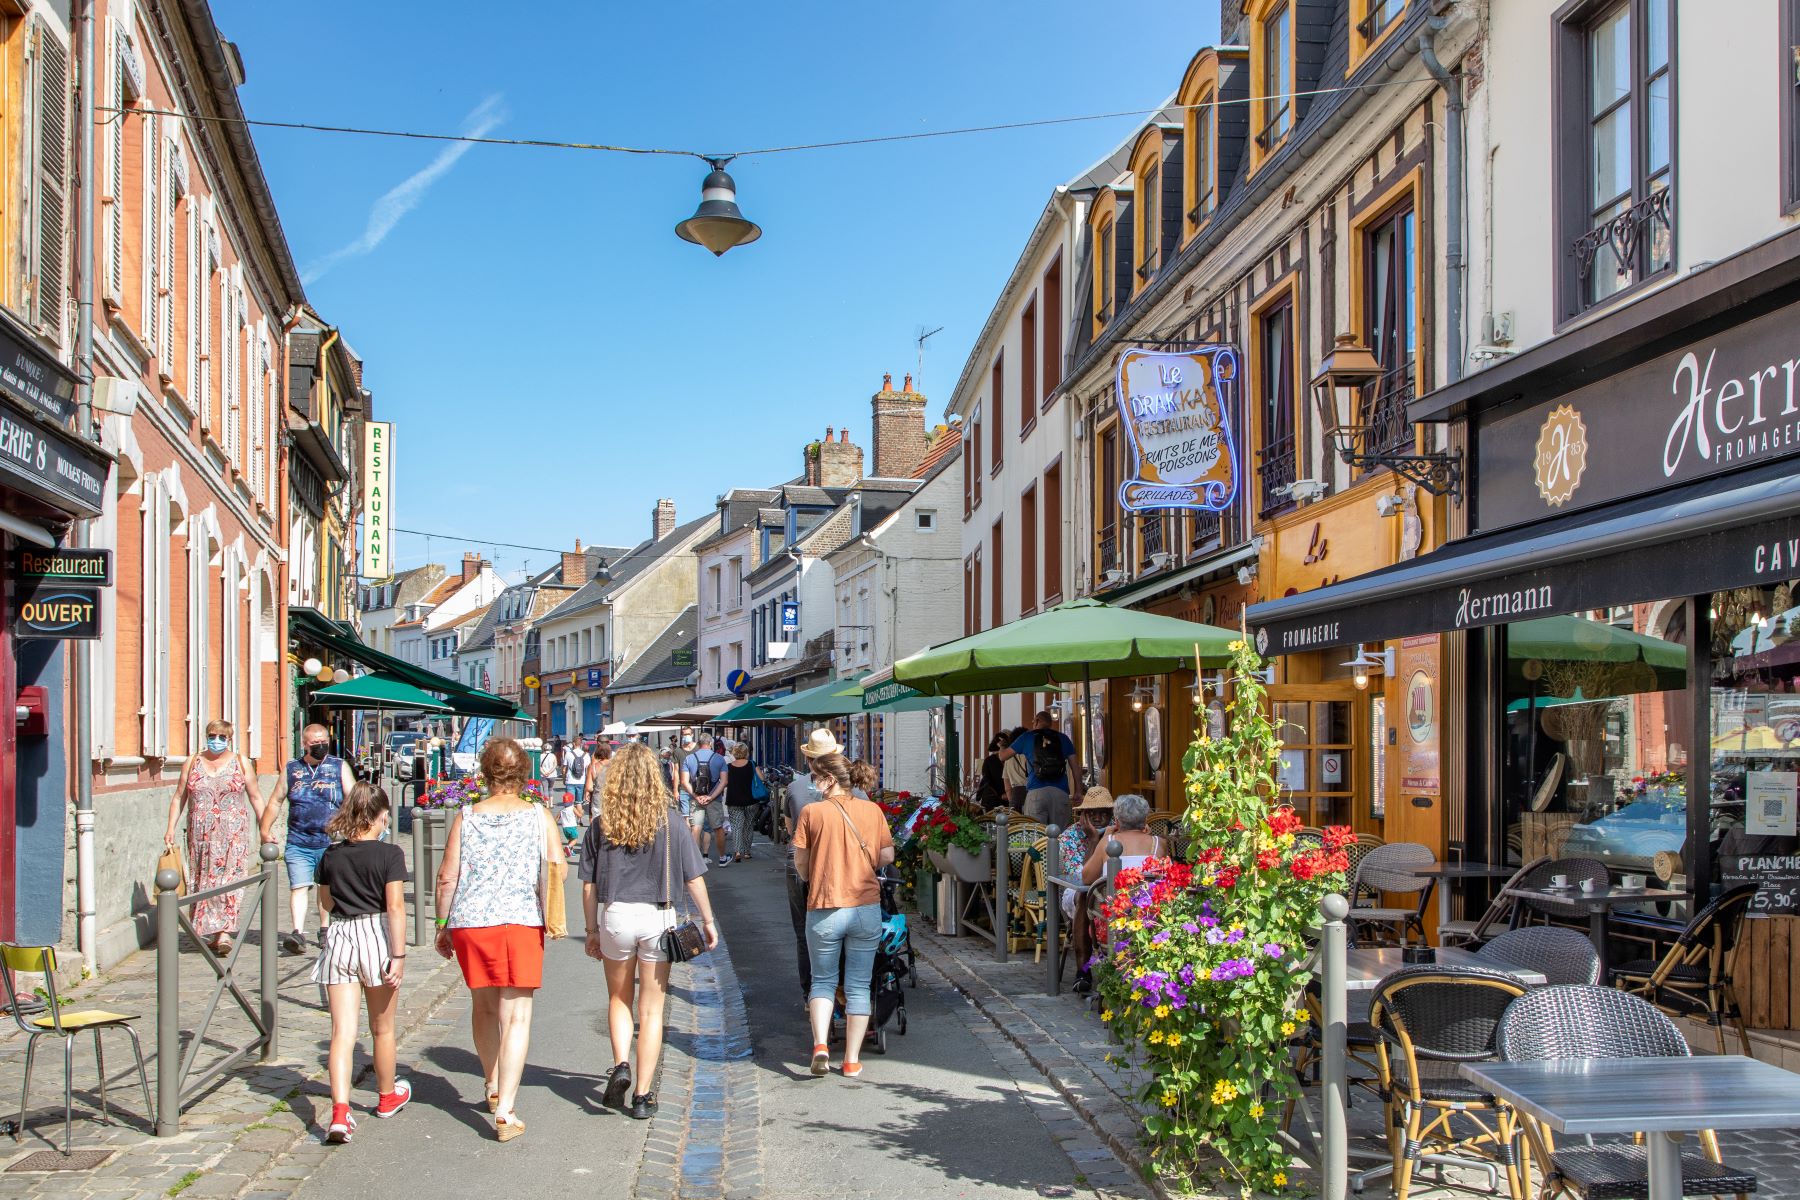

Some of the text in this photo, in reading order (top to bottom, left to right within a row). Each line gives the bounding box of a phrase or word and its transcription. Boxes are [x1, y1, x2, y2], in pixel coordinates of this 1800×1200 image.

[1140, 430, 1226, 466] FRUITS DE MER
[1542, 450, 1552, 466] 19
[1570, 440, 1581, 457] 85
[36, 439, 47, 471] 8
[56, 456, 82, 484] MOULES
[81, 471, 100, 496] FRITES
[1158, 448, 1218, 475] POISSONS
[371, 427, 382, 569] RESTAURANT
[1136, 489, 1197, 503] GRILLADES
[1303, 522, 1328, 566] Le
[23, 552, 105, 575] Restaurant
[21, 602, 94, 623] OUVERT
[1455, 584, 1553, 628] Hermann
[1283, 622, 1339, 648] FROMAGERIE
